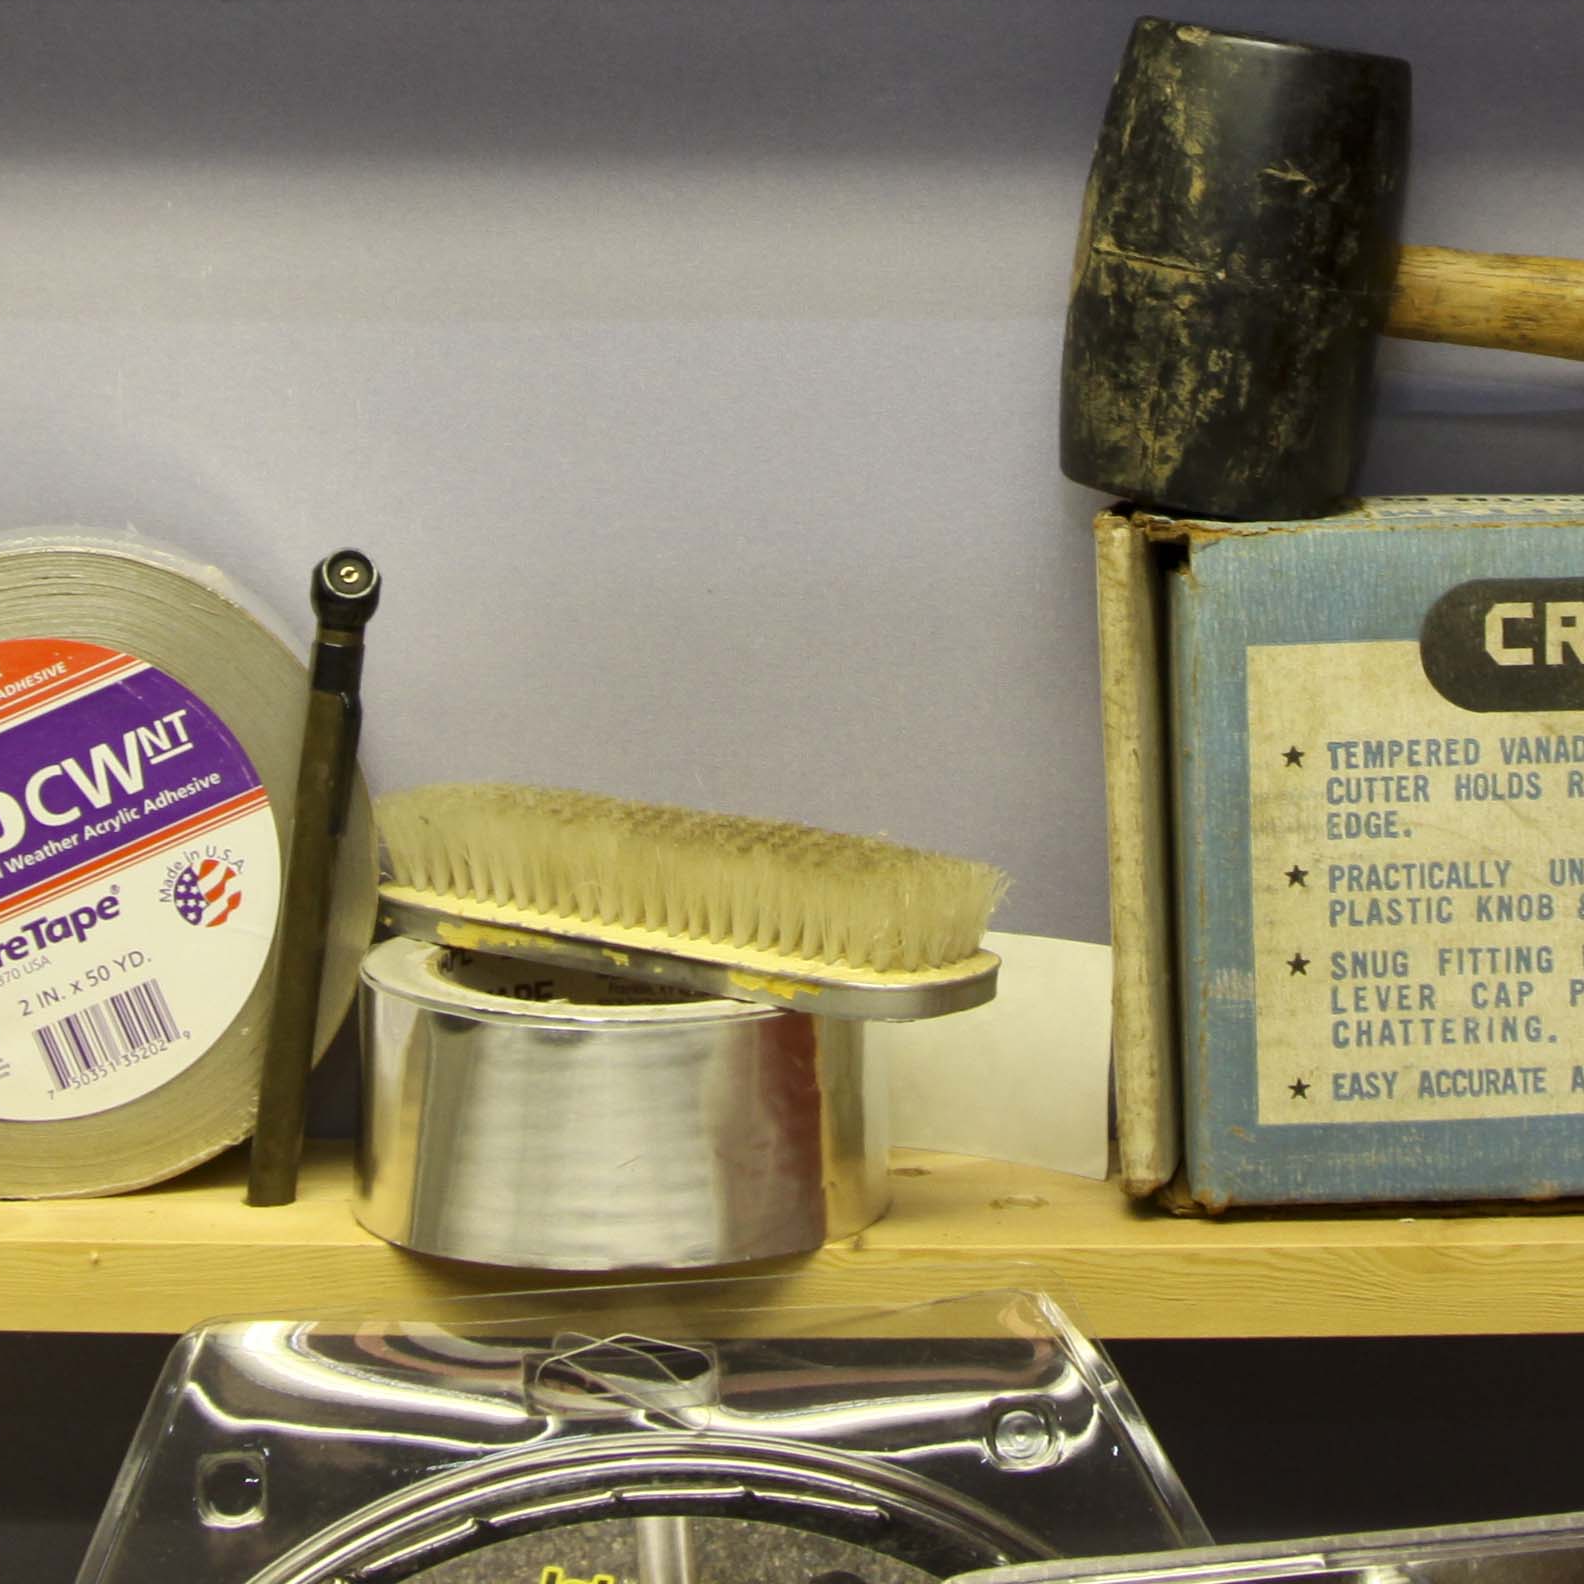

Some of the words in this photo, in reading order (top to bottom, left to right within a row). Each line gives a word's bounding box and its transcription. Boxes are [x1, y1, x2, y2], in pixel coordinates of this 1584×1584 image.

[1326, 740, 1480, 771] TEMPERED
[1326, 775, 1430, 806] CUTTER
[1455, 772, 1542, 802] HOLDS
[4, 833, 79, 875] Weather
[83, 807, 141, 841] Acrylic
[143, 772, 222, 815] Adhesive
[1326, 811, 1413, 842] EDGE.
[1328, 859, 1511, 893] PRACTICALLY
[1328, 896, 1452, 927] PLASTIC
[1476, 893, 1555, 923] KNOB
[22, 955, 53, 976] USA
[1330, 950, 1409, 980] SNUG
[1438, 945, 1554, 976] FITTING
[18, 1000, 33, 1017] 2
[36, 987, 66, 1007] IN.
[70, 980, 83, 995] x
[84, 966, 111, 988] 50
[114, 949, 152, 975] YD.
[1331, 983, 1436, 1014] LEVER
[1470, 981, 1534, 1009] CAP
[1332, 1016, 1558, 1049] CHATTERING.
[1333, 1071, 1398, 1102] EASY
[1419, 1066, 1546, 1099] ACCURATE
